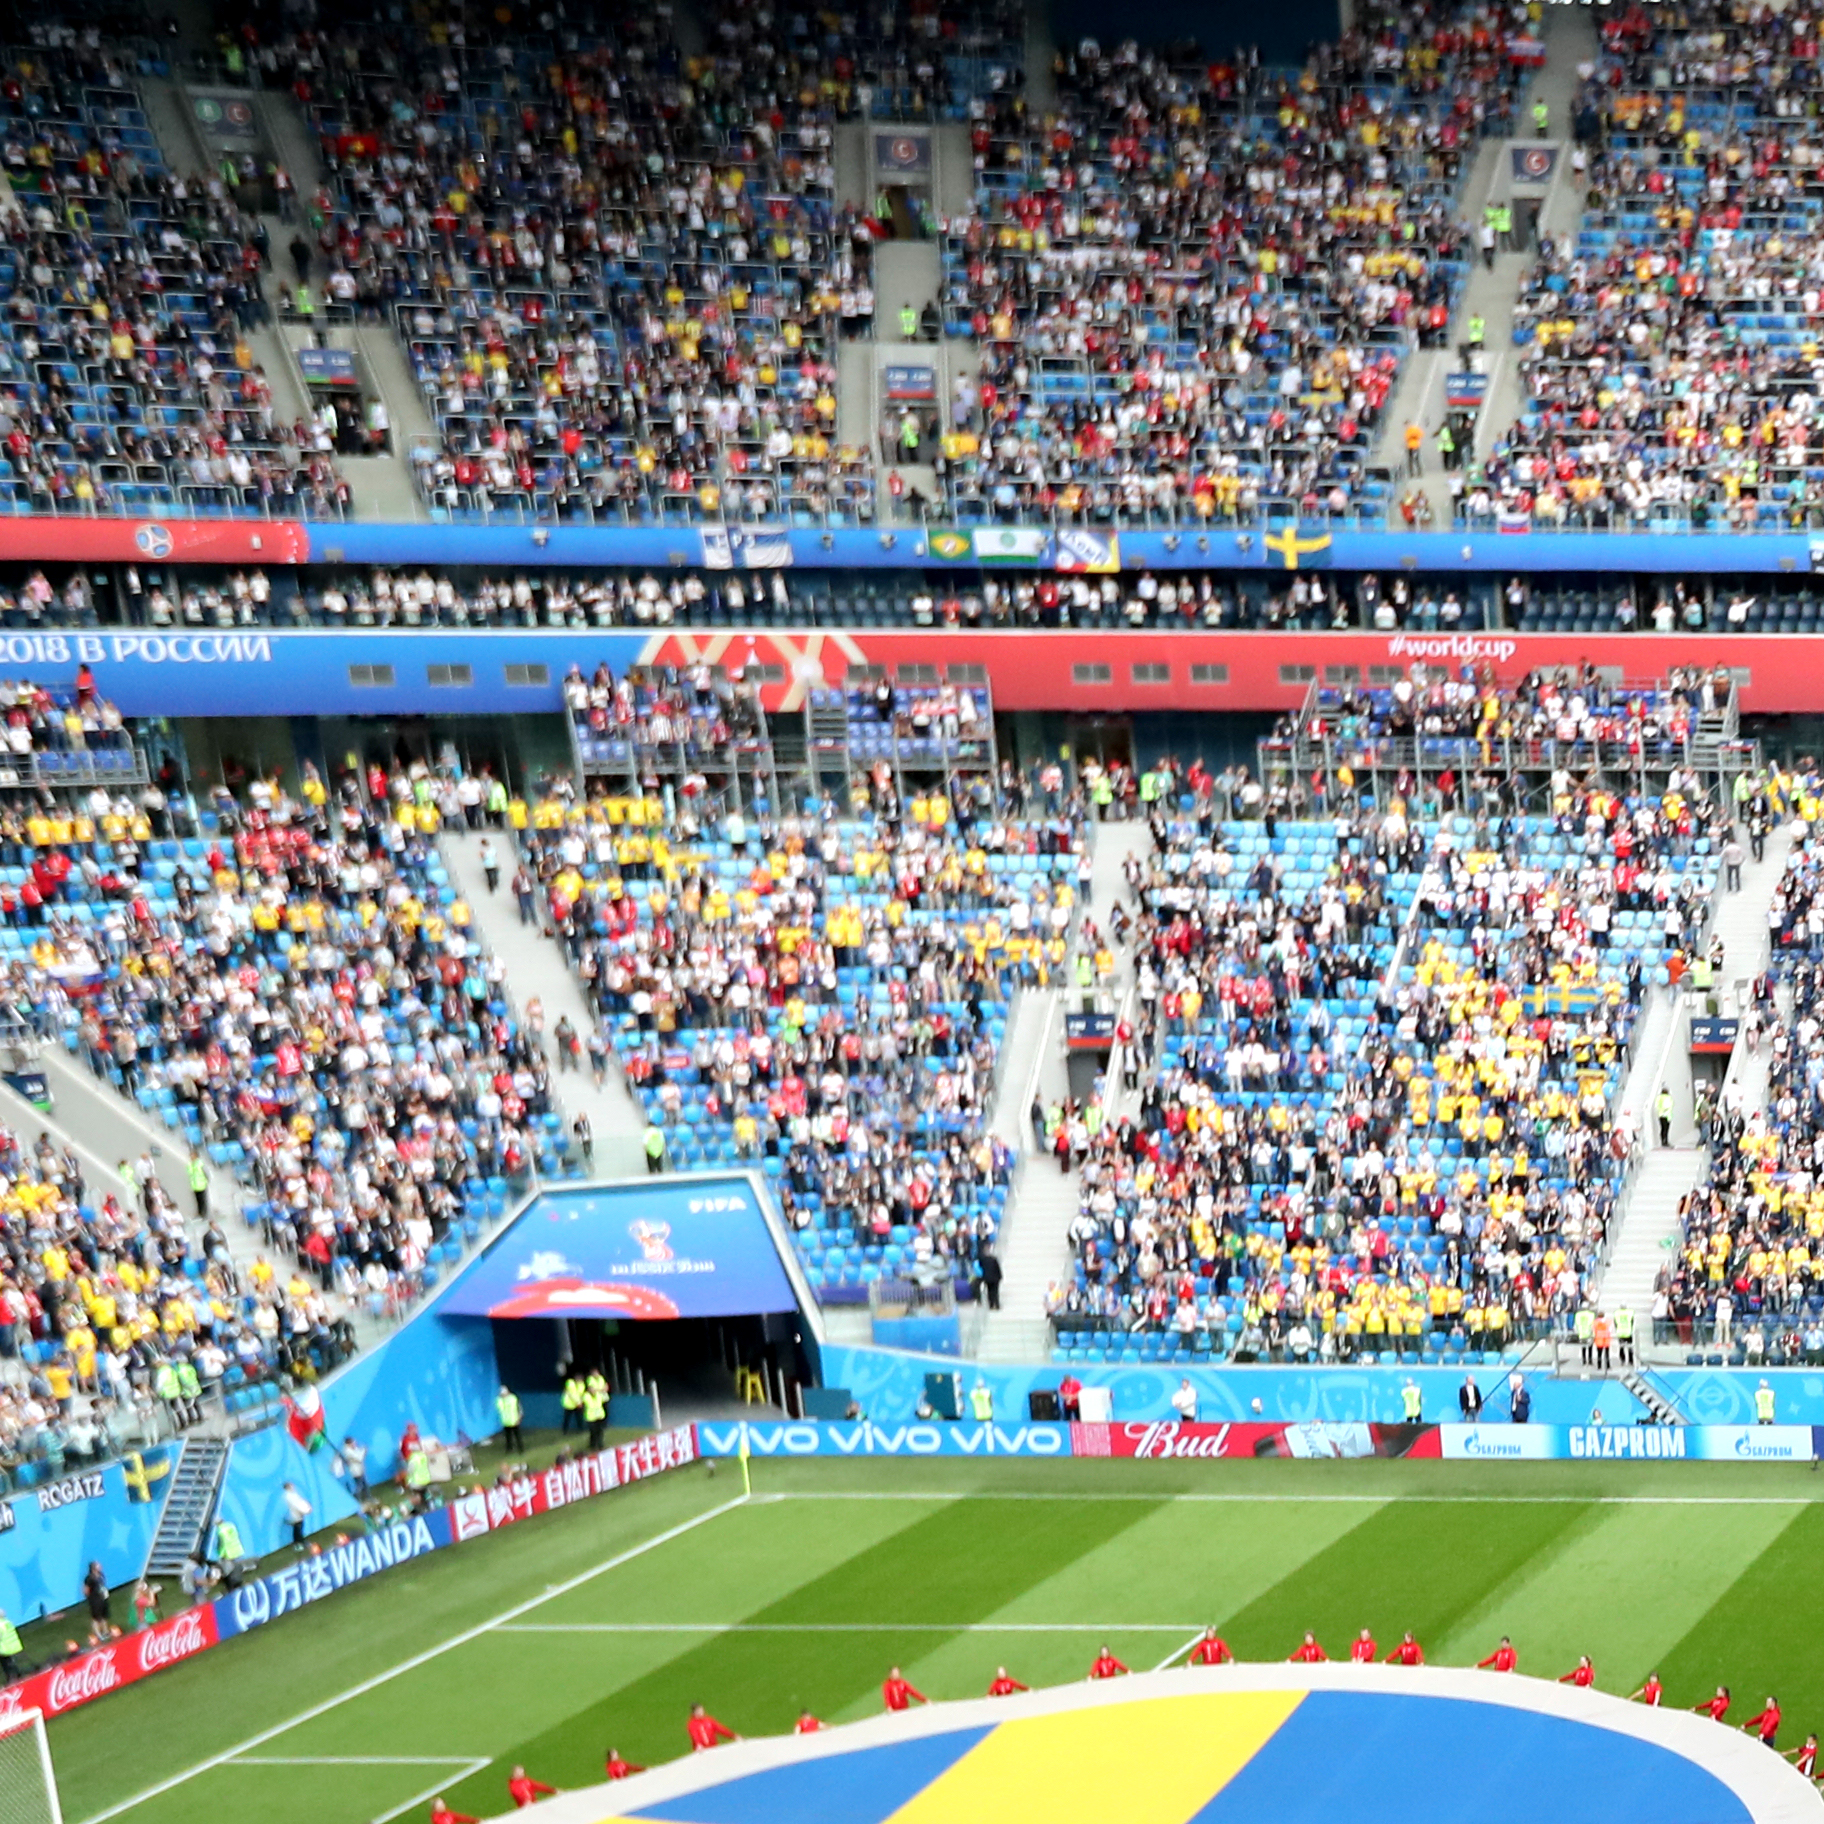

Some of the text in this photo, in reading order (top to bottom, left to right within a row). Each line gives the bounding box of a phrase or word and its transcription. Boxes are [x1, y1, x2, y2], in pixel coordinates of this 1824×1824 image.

[76, 635, 107, 662] В
[115, 635, 272, 663] РОССИИ
[1388, 635, 1517, 662] #worldcup
[688, 1196, 747, 1214] FIFA
[703, 1423, 1062, 1457] vivo vivo vivo
[1124, 1421, 1230, 1459] Bud
[1568, 1426, 1686, 1458] GAZPROM
[331, 1515, 435, 1584] WANDA
